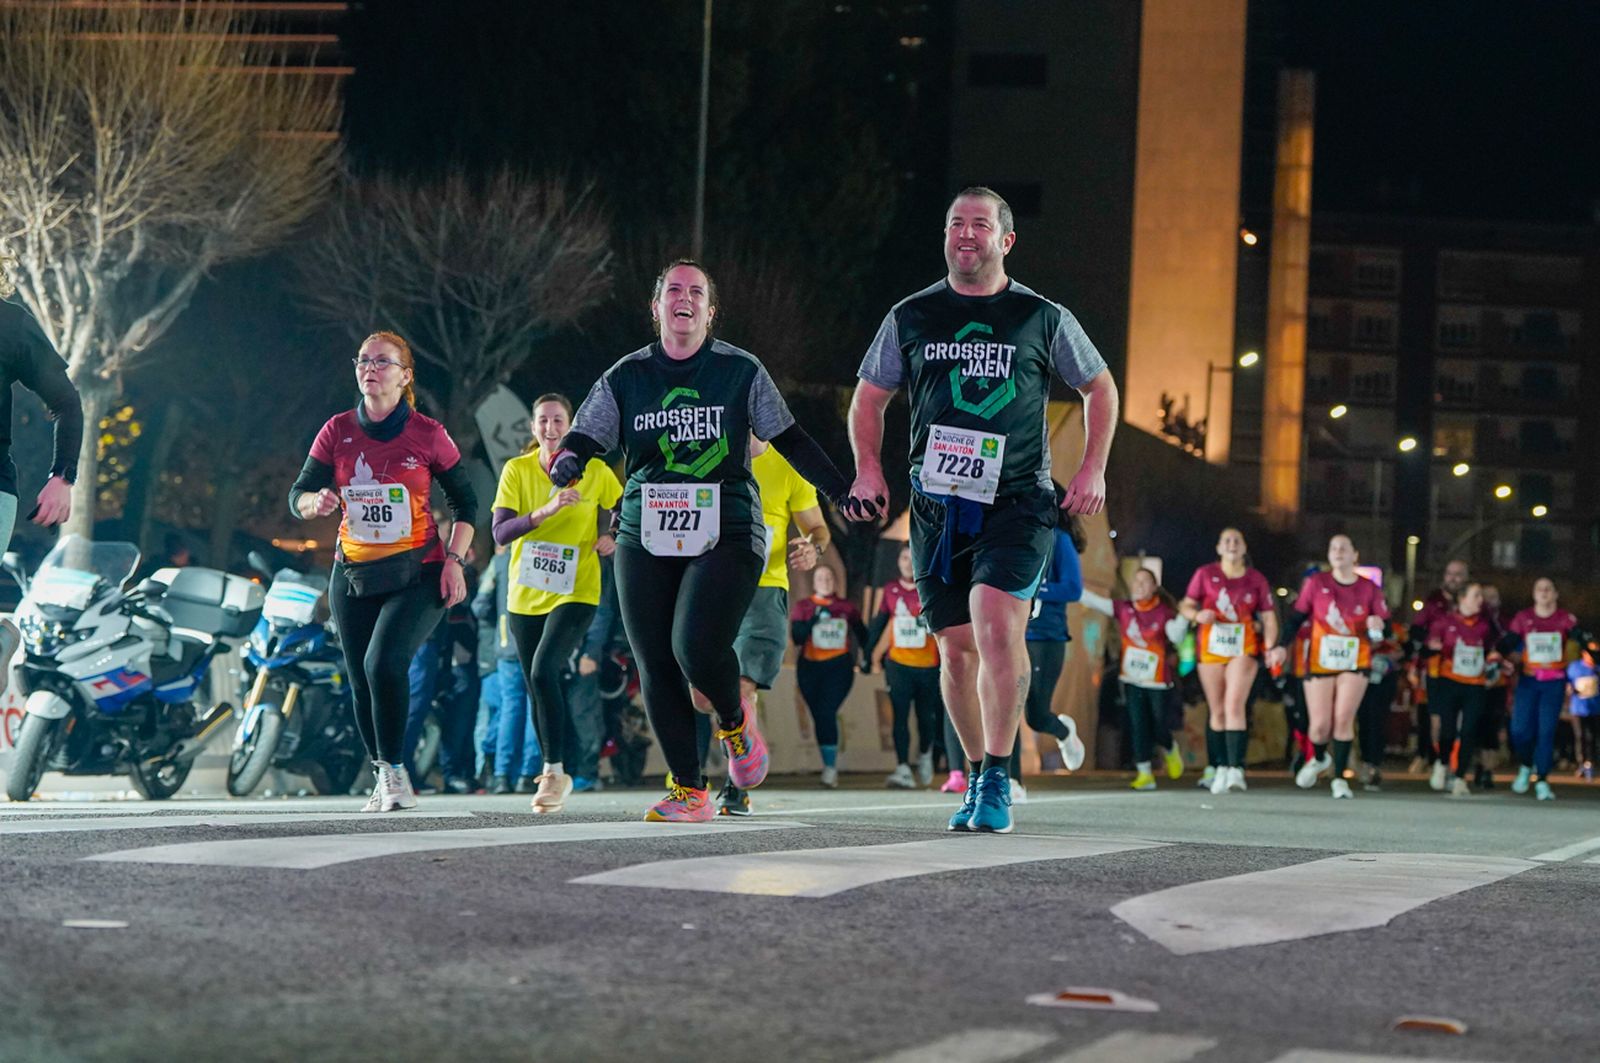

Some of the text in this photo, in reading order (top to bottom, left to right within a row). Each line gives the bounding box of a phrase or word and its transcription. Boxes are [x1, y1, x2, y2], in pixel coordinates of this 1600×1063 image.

[924, 342, 1016, 360] CROSSFIT
[962, 359, 1011, 379] JAEN
[634, 405, 725, 432] CROSSFIT
[670, 421, 720, 442] JAEN
[942, 435, 975, 446] NOCHE DE
[933, 442, 946, 451] SAN
[936, 452, 985, 479] 7228
[361, 504, 393, 523] 286
[657, 510, 701, 531] 7227
[533, 556, 566, 575] 6263
